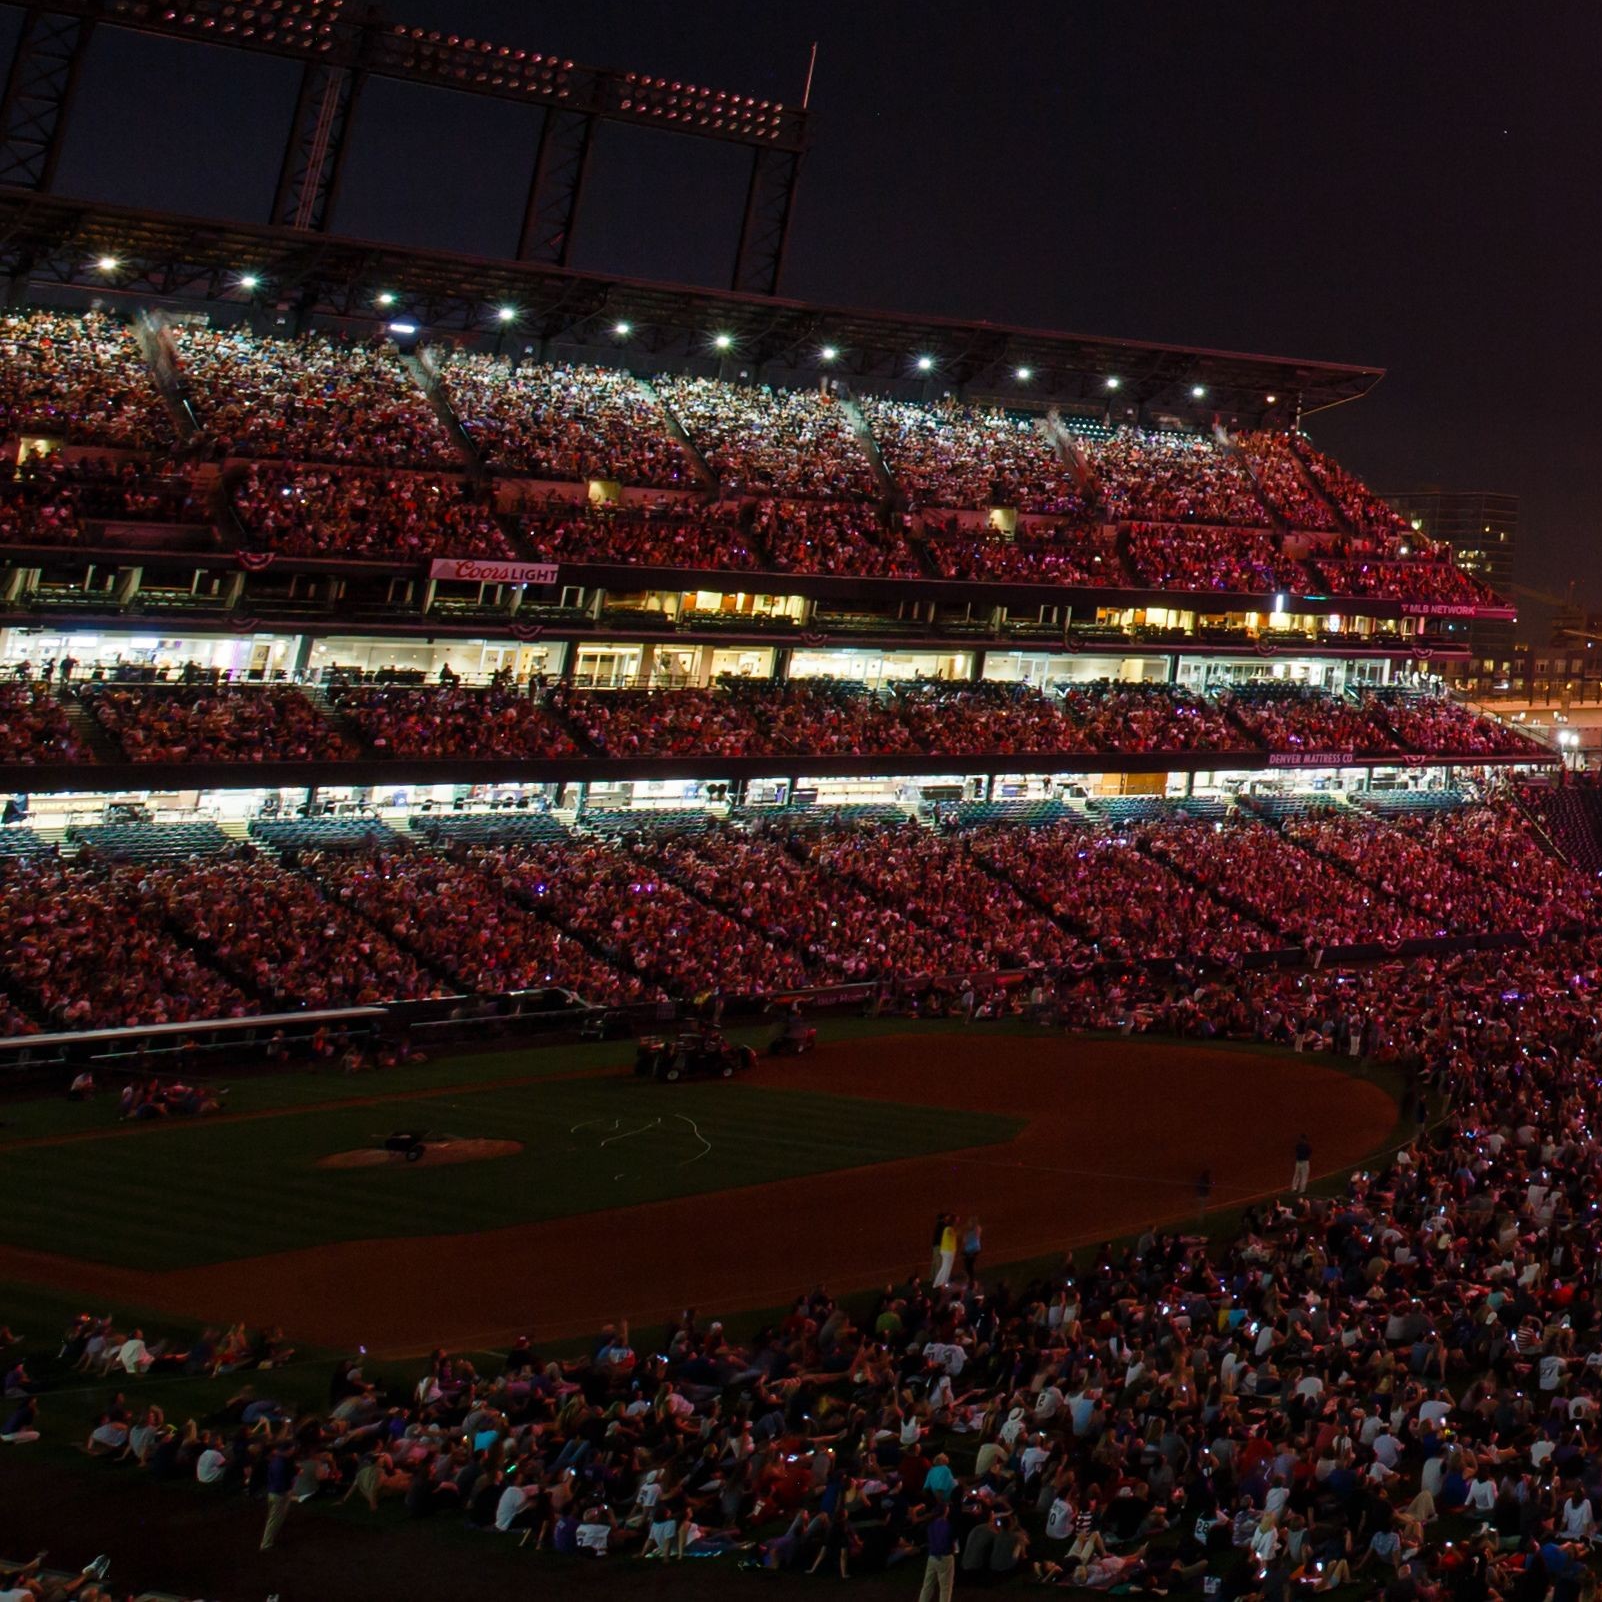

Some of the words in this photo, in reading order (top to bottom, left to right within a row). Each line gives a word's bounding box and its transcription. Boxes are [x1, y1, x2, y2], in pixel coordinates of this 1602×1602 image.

[455, 559, 509, 579] Coors
[510, 569, 558, 582] LIGHT
[1409, 604, 1429, 614] MLB
[1430, 605, 1476, 616] NETWORK
[1269, 754, 1301, 764] DENVER
[1303, 753, 1341, 764] MATTRESS
